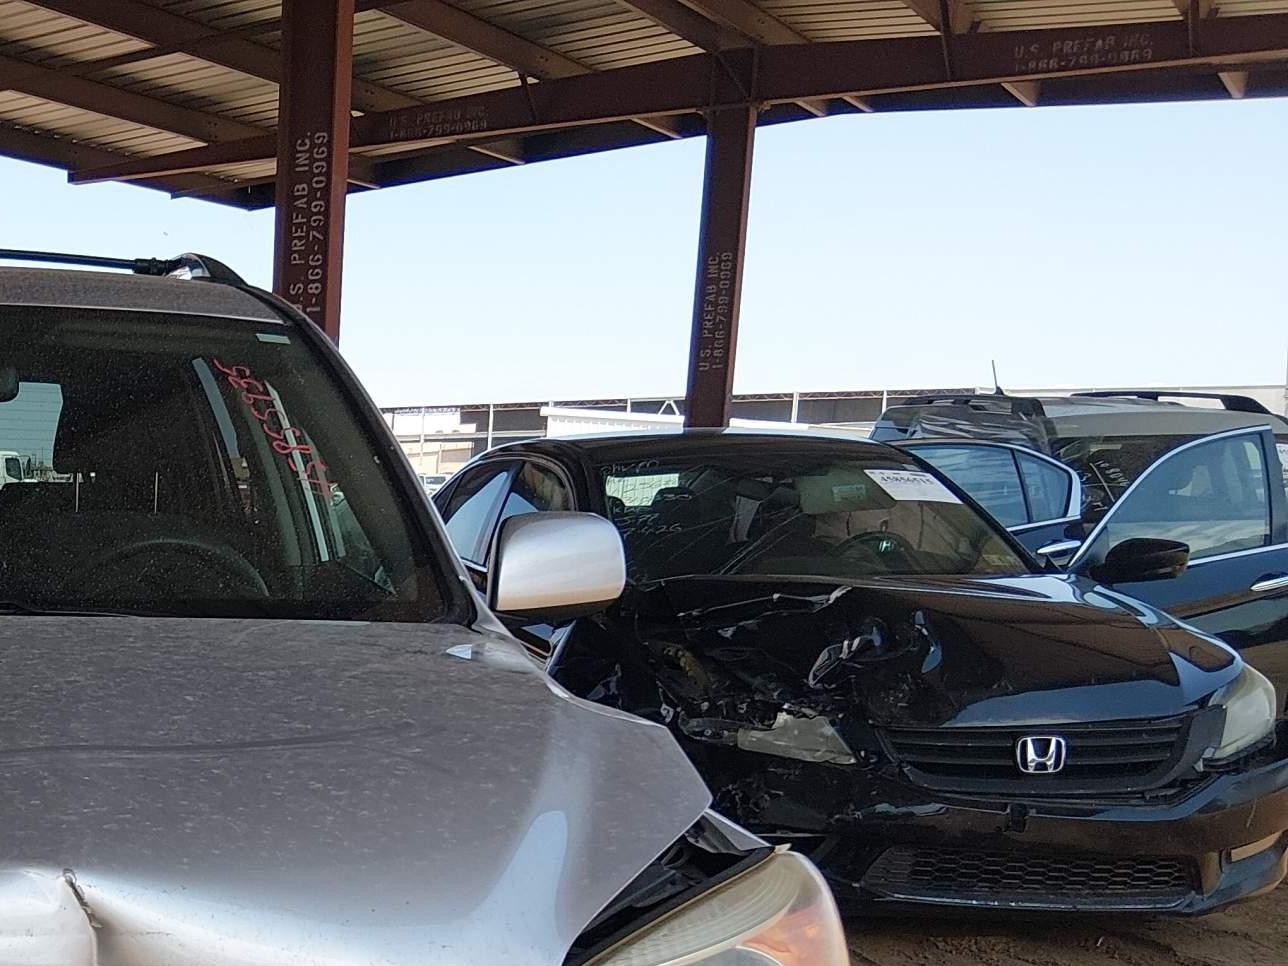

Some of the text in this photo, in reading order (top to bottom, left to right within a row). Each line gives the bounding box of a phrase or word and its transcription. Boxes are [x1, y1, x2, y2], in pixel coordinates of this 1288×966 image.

[295, 131, 311, 172] INC.
[291, 183, 308, 265] PREFAB
[306, 131, 329, 314] 1-866-799-0969
[702, 284, 717, 338] PREFAB
